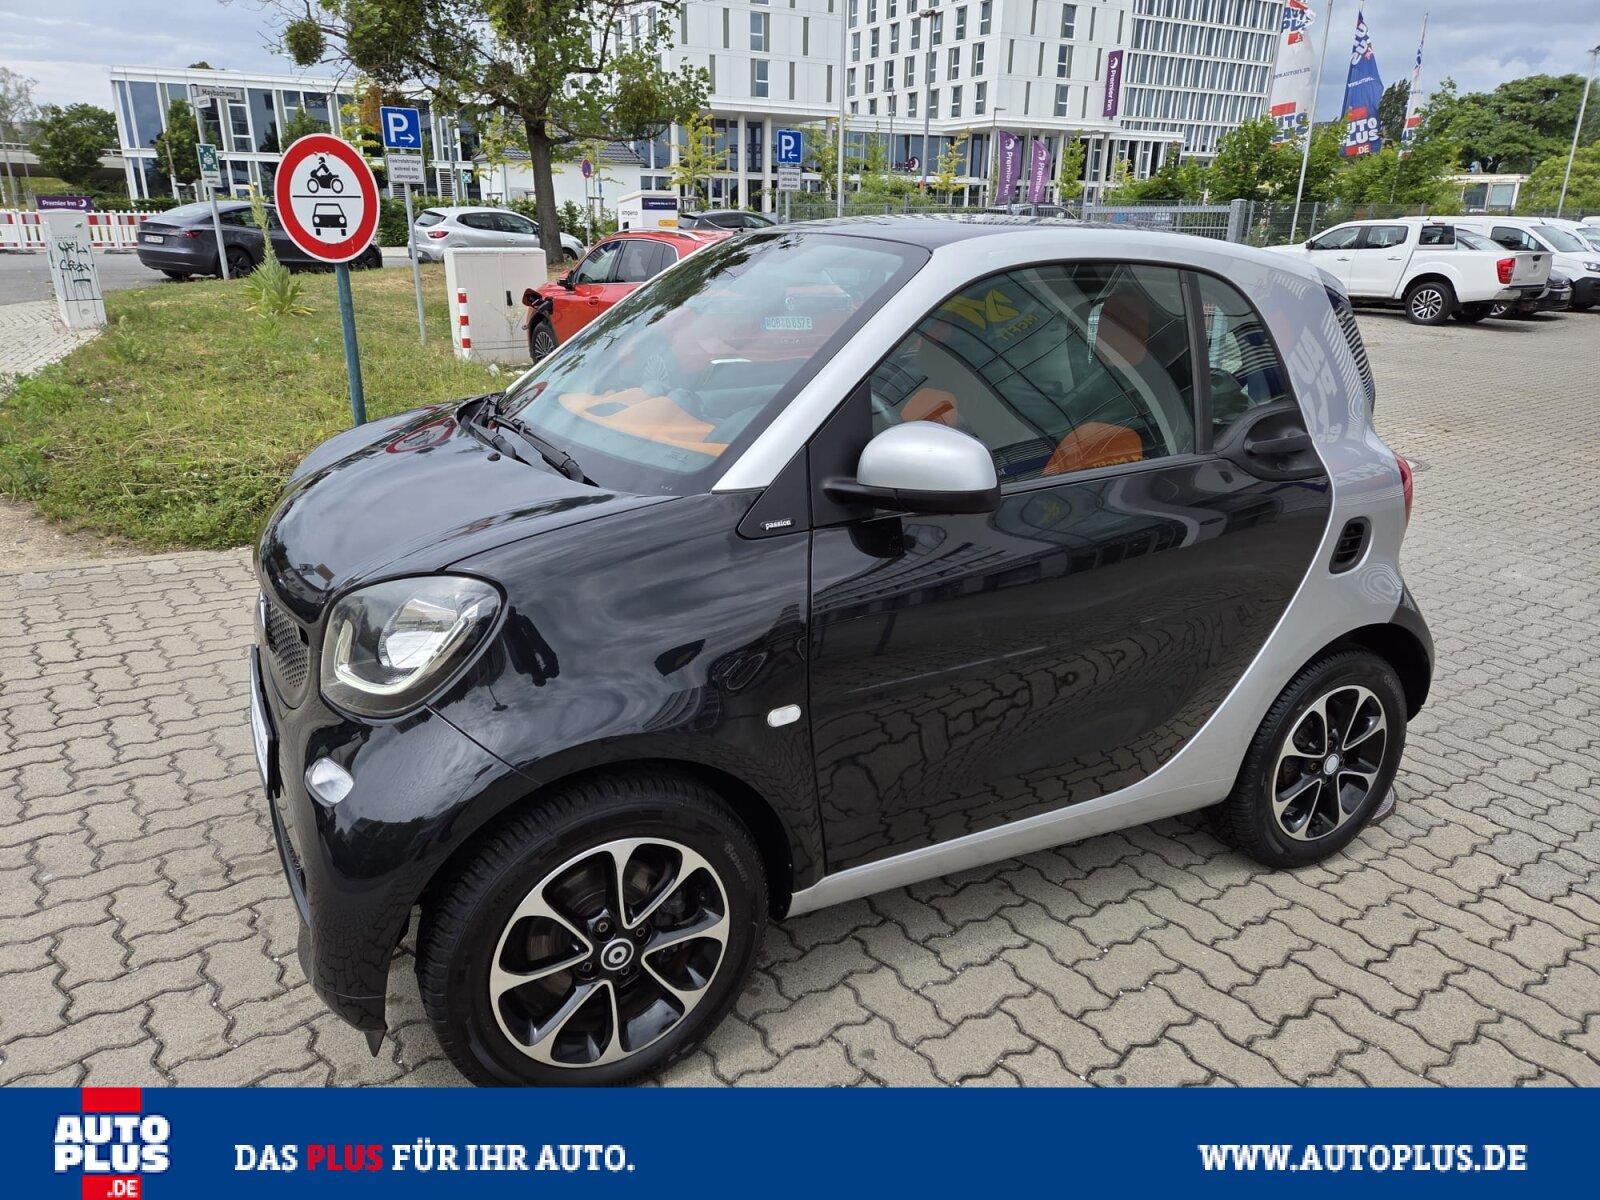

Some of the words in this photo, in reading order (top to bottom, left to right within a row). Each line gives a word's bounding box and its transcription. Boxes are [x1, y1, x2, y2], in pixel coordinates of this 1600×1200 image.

[1108, 70, 1117, 100] Premier
[388, 113, 409, 143] P
[781, 135, 795, 159] P
[1004, 151, 1014, 184] Premier
[42, 199, 67, 207] Premier
[765, 519, 792, 530] passion
